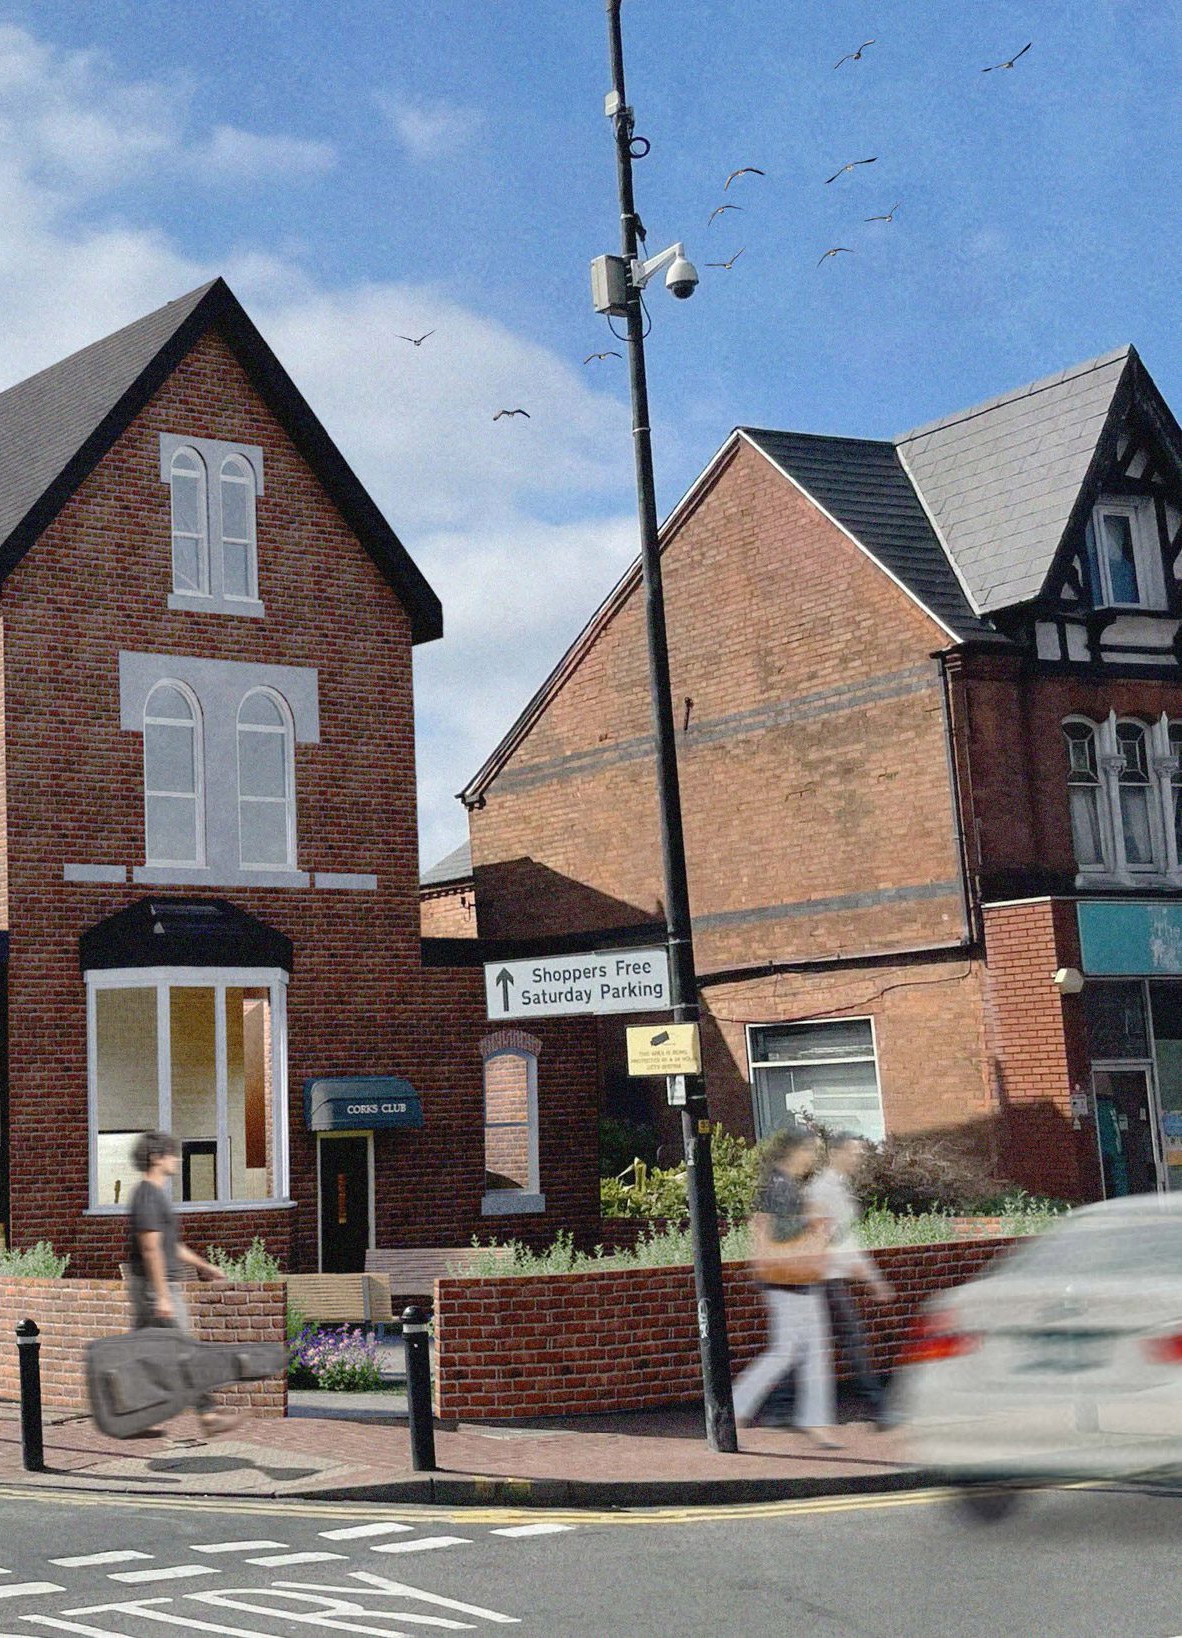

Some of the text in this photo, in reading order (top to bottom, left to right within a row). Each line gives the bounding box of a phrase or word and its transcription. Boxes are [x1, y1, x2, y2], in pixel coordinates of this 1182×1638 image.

[532, 959, 652, 984] Shoppers Free
[521, 981, 664, 1005] Saturday Parking
[347, 1103, 407, 1114] CORKS CLUB
